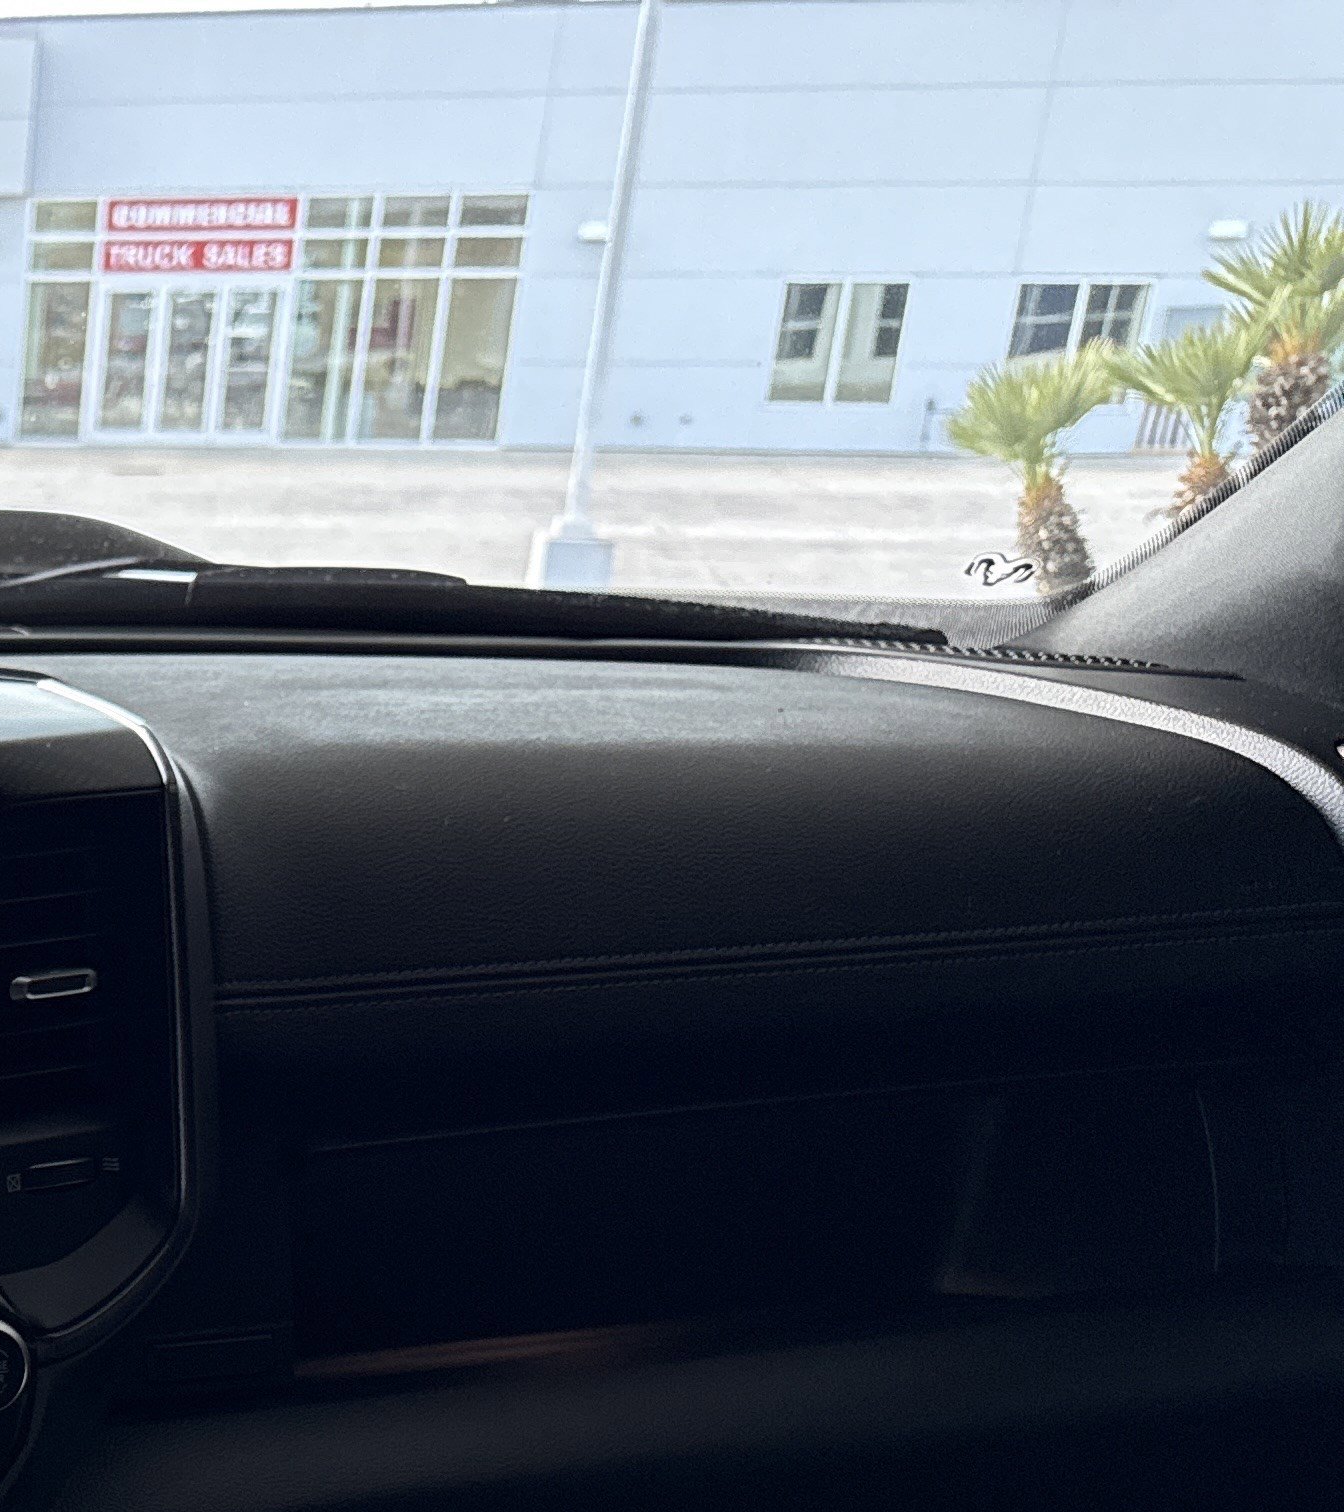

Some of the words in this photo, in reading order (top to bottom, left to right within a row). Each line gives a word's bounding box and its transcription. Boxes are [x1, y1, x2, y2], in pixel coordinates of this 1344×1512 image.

[112, 202, 291, 228] COMMERCIAL
[109, 241, 193, 269] TRUCK
[202, 240, 289, 269] SALES
